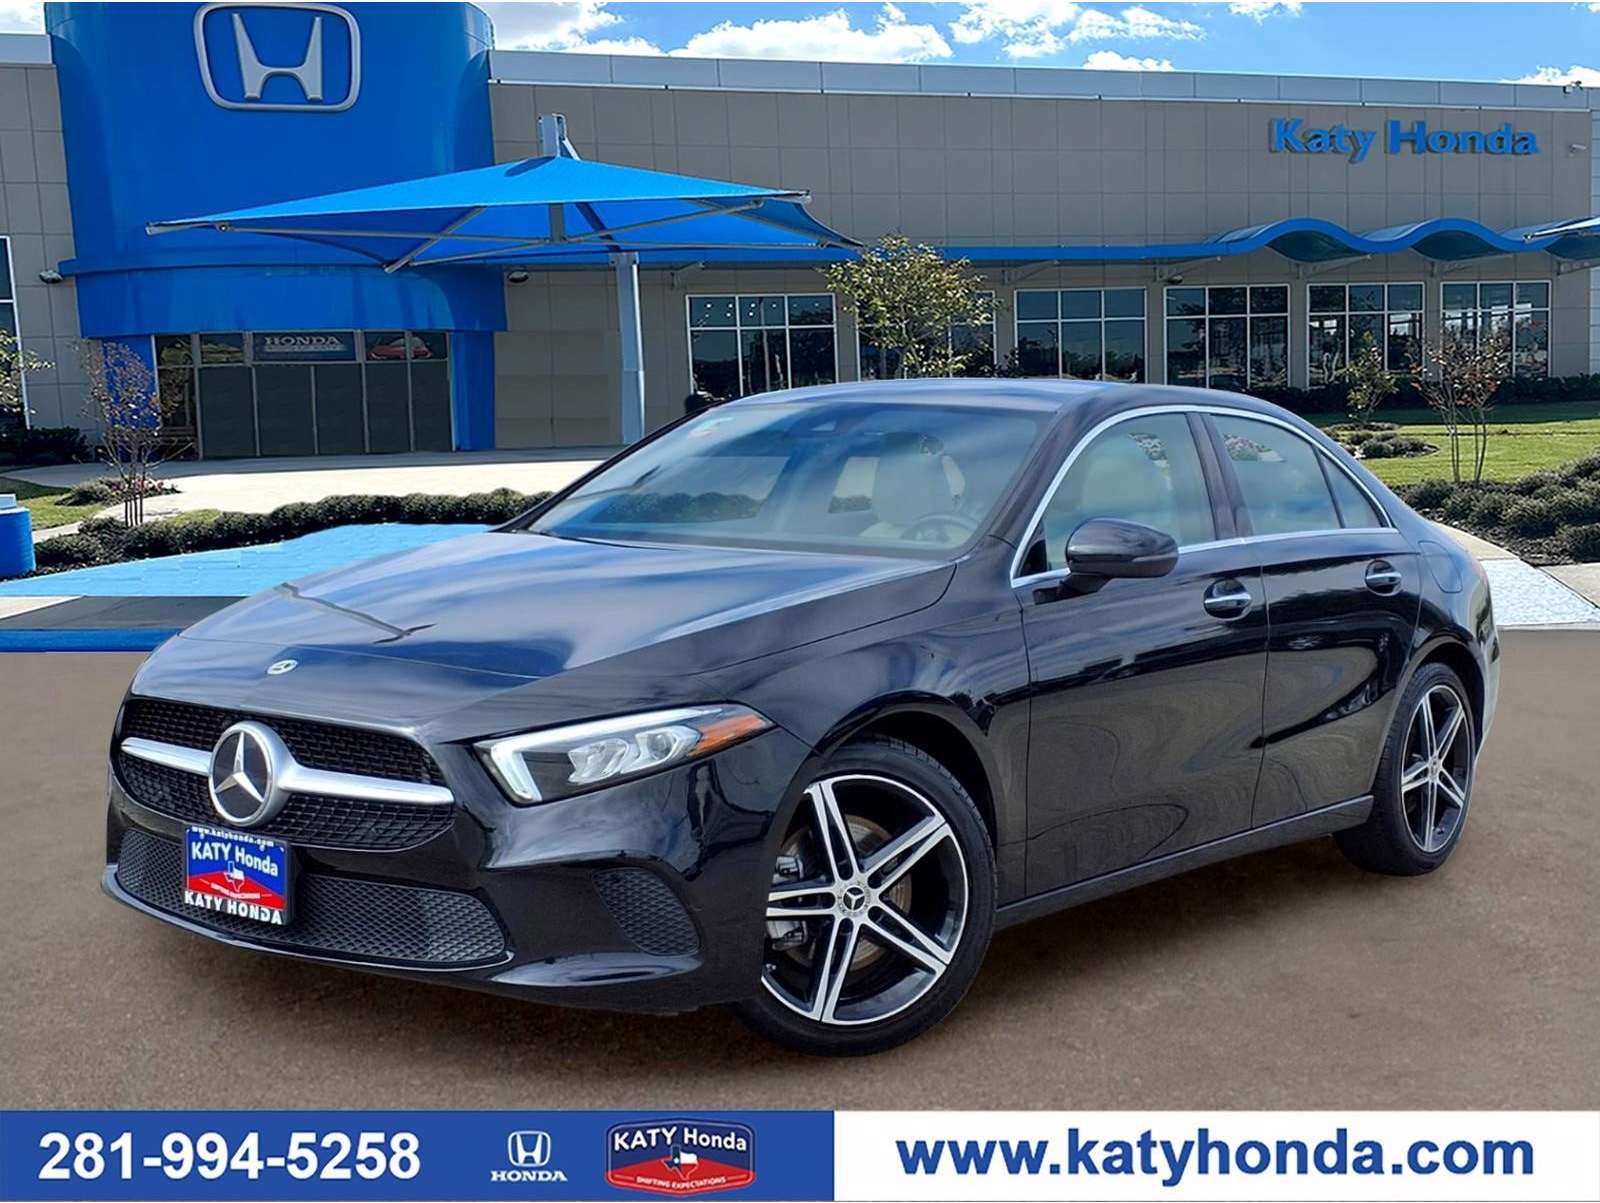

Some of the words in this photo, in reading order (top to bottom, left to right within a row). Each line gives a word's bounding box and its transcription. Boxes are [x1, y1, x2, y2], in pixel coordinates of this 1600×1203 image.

[1270, 118, 1376, 163] Katy
[1387, 119, 1540, 155] Honda
[264, 336, 342, 345] HONDA
[191, 841, 232, 861] KATY
[234, 845, 279, 877] Honda
[184, 890, 223, 911] KATY
[227, 899, 283, 925] HONDA
